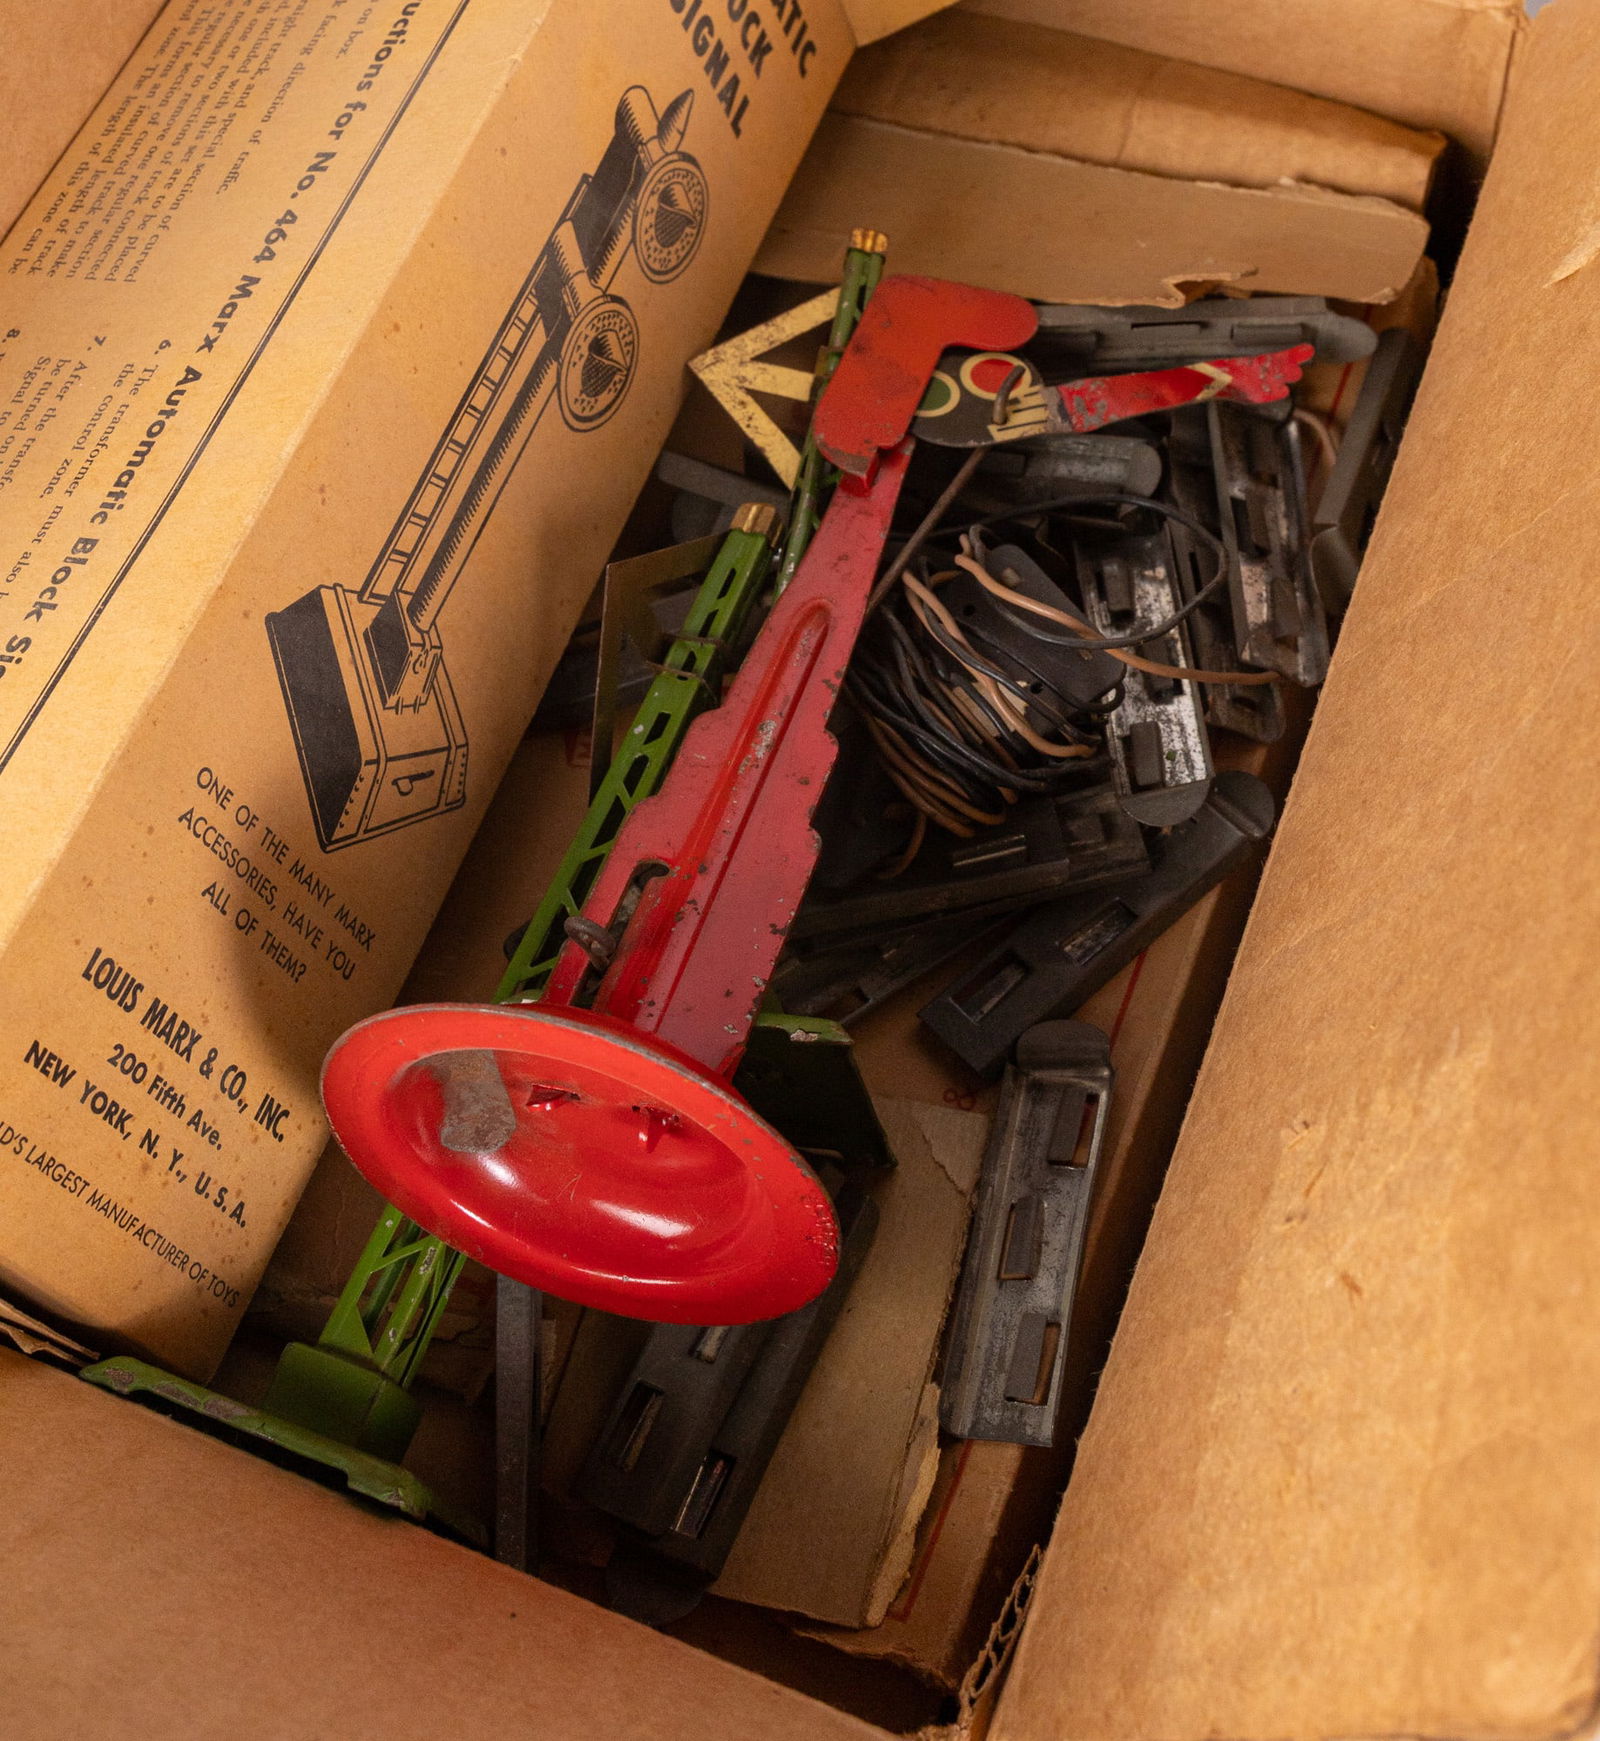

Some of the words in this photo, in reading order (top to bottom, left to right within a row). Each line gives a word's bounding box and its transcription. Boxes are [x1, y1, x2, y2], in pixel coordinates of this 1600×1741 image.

[187, 6, 216, 36] This
[191, 12, 226, 58] regular
[238, 18, 258, 42] one
[299, 15, 337, 56] facing
[357, 8, 372, 25] on
[159, 41, 192, 78] forms
[200, 11, 245, 70] necessary
[227, 45, 240, 60] or
[236, 17, 278, 74] included
[336, 30, 364, 59] box.
[133, 64, 160, 90] The
[146, 83, 161, 98] an
[158, 62, 193, 107] section
[190, 74, 205, 88] to
[208, 65, 229, 90] two
[214, 78, 240, 109] with
[234, 83, 255, 108] and
[261, 62, 305, 123] direction
[100, 95, 138, 137] length
[101, 105, 150, 164] insulated
[147, 112, 160, 126] of
[156, 93, 192, 141] remove
[171, 94, 210, 147] sections
[195, 115, 217, 140] this
[202, 112, 237, 158] special
[328, 101, 367, 140] for
[88, 142, 102, 156] of
[113, 130, 148, 175] curved
[248, 130, 262, 145] of
[67, 161, 90, 186] this
[137, 145, 158, 170] one
[160, 151, 173, 165] of
[216, 151, 250, 194] traffic.
[290, 152, 337, 199] No.
[68, 169, 107, 213] length
[85, 180, 116, 216] track
[133, 170, 162, 205] track
[163, 168, 182, 190] are
[169, 163, 205, 210] section
[42, 192, 68, 223] zone
[102, 174, 139, 224] regular
[151, 195, 166, 209] to
[22, 228, 43, 252] can
[55, 219, 69, 234] of
[75, 221, 89, 234] to
[137, 214, 157, 230] be
[157, 215, 172, 231] of
[252, 209, 298, 264] 464
[26, 240, 56, 275] track
[47, 239, 76, 278] make
[65, 229, 103, 278] section
[84, 209, 135, 280] connected
[104, 236, 139, 282] placed
[123, 234, 159, 282] curved
[8, 258, 28, 274] be
[195, 275, 261, 353] Marx
[2, 328, 21, 343] 8.
[87, 335, 106, 351] 7.
[154, 339, 171, 355] 6.
[10, 356, 51, 403] Signal
[50, 359, 72, 376] be
[55, 360, 88, 401] After
[113, 363, 134, 387] the
[129, 364, 159, 396] The
[13, 381, 53, 431] turned
[34, 407, 56, 431] the
[72, 395, 113, 450] control
[64, 404, 129, 497] transformer
[90, 365, 202, 524] Automatic
[39, 458, 73, 498] zone.
[31, 505, 63, 544] must
[6, 551, 32, 583] also
[23, 537, 100, 622] Block
[197, 767, 234, 811] ONE
[235, 805, 259, 832] OF
[260, 826, 289, 865] THE
[288, 857, 336, 907] MANY
[333, 903, 376, 952] MARX
[178, 806, 277, 911] ACCESSORIES,
[282, 901, 324, 950] HAVE
[325, 940, 356, 980] YOU
[201, 881, 231, 916] ALL
[235, 908, 259, 936] OF
[260, 930, 307, 983] THEM?
[81, 947, 144, 1013] LOUIS
[140, 997, 202, 1063] MARX
[199, 1047, 218, 1080] &
[220, 1064, 248, 1114] CO.,
[254, 1093, 290, 1143] INC.
[23, 1039, 77, 1088] NEW
[80, 1079, 134, 1141] YORK,
[139, 1128, 160, 1159] N.
[107, 1043, 148, 1084] 200
[147, 1074, 186, 1119] Fifth
[186, 1109, 222, 1151] Ave.
[25, 1145, 90, 1198] LARGEST
[86, 1189, 190, 1272] MANUFACTURER
[188, 1262, 209, 1283] OF
[207, 1274, 240, 1307] TOYS
